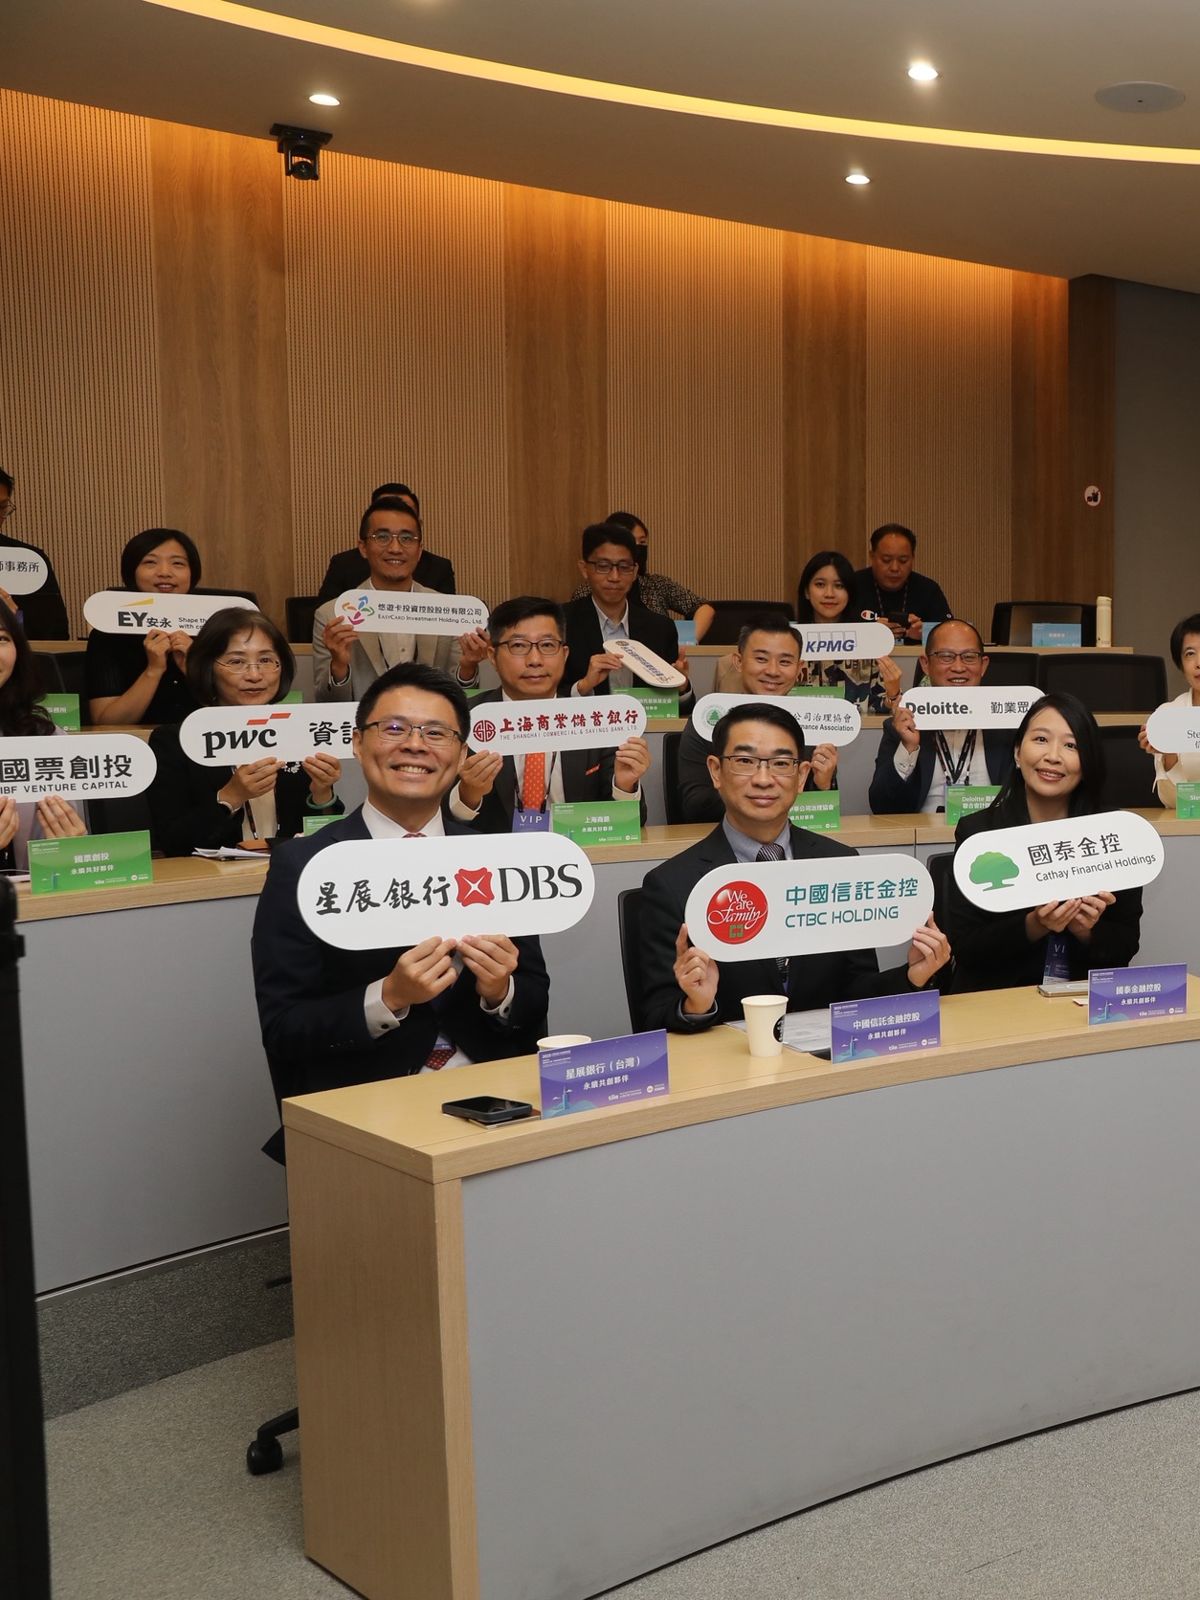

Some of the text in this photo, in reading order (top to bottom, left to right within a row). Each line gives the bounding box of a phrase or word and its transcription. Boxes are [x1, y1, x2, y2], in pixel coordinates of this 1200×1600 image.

[378, 603, 482, 617] 悠遊卡投資控股股份有限公司
[118, 611, 172, 628] EY 安永
[439, 617, 460, 625] Holding
[806, 640, 855, 653] KPMG
[991, 701, 1035, 714] 勤業眾
[500, 709, 638, 733] 上海商業儲蓄銀行
[793, 712, 851, 723] 公司治理協會
[543, 730, 577, 738] COMMERCIAL
[202, 729, 277, 759] pwc
[0, 754, 132, 783] 國票創投
[0, 781, 128, 794] IBF VENTURE CAPITAL
[520, 815, 543, 824] VIP
[1027, 832, 1123, 866] 國泰金控
[1035, 854, 1156, 882] Cathay Financial Holdings
[498, 863, 583, 903] DBS
[315, 875, 450, 916] 星展銀行
[727, 890, 748, 903] We
[786, 878, 919, 905] 中國信託金控
[735, 900, 754, 910] are
[785, 906, 899, 928] CTBC HOLDING
